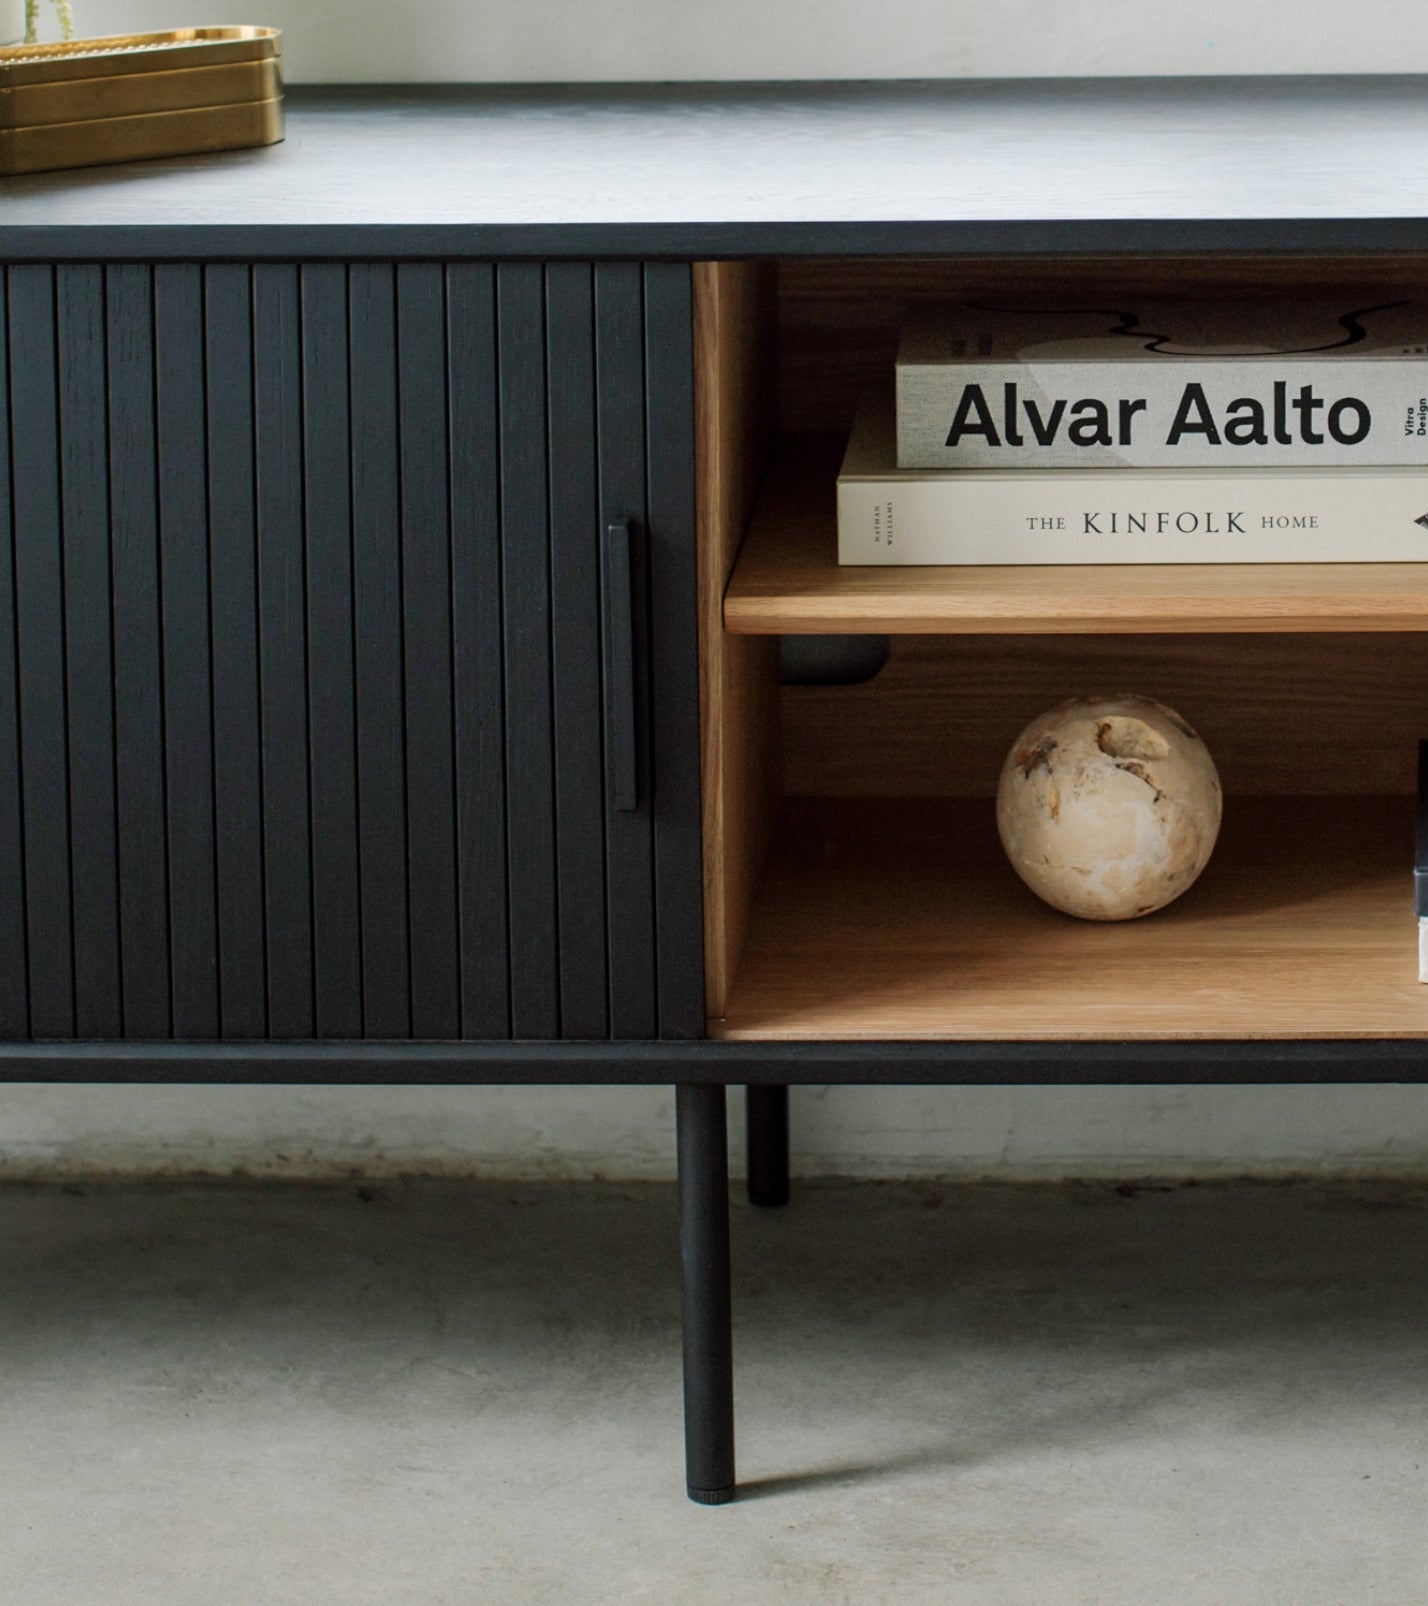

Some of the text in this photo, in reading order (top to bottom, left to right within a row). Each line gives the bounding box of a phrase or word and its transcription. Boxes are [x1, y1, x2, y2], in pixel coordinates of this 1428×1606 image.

[945, 380, 1372, 447] Alvar Aalto
[1405, 407, 1414, 436] Vitra
[1417, 398, 1428, 436] Design
[1026, 511, 1319, 534] THE KINFOLK HOME
